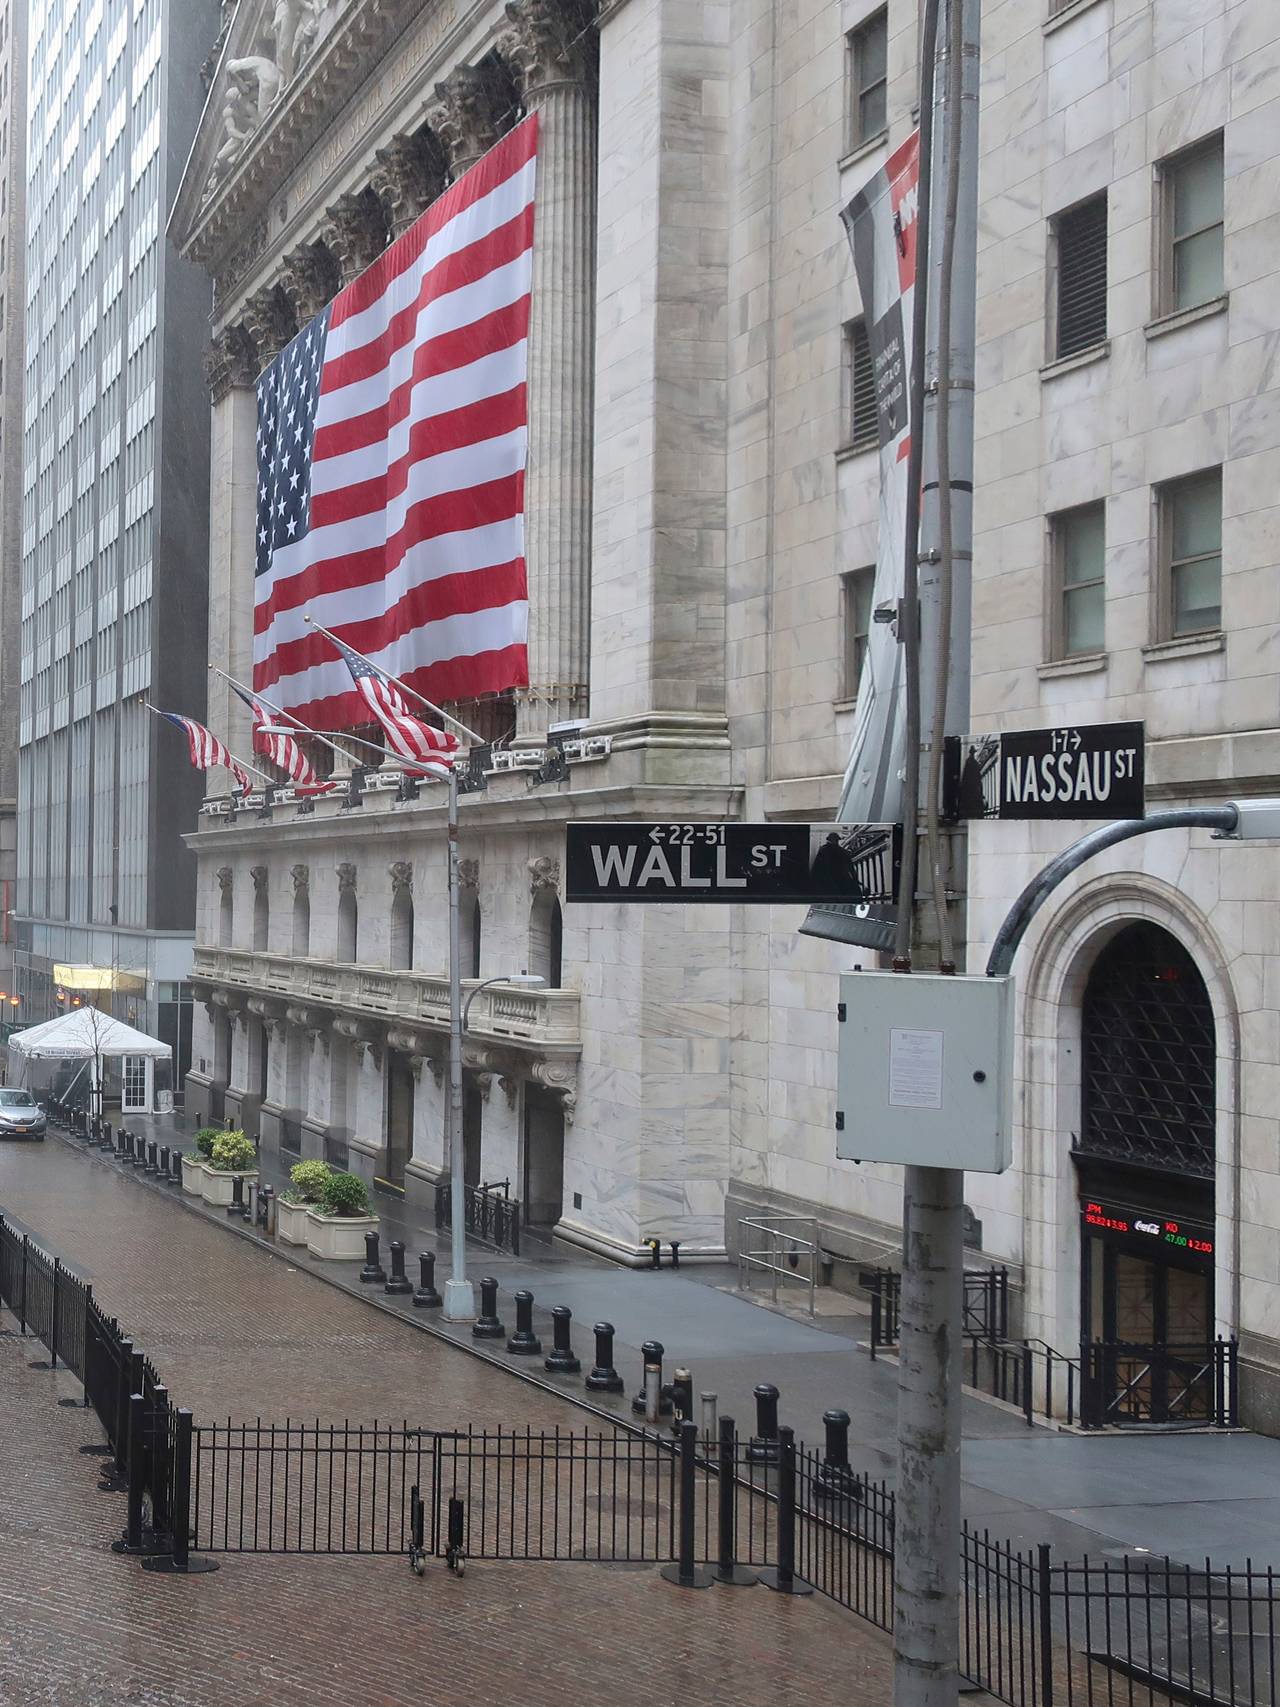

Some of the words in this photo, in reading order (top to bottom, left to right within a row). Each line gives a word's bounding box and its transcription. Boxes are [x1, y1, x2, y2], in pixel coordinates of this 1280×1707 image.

[1051, 730, 1068, 752] 1-7
[1006, 751, 1111, 802] NASSAU
[1115, 749, 1136, 778] ST
[669, 825, 725, 845] 22-51
[591, 845, 747, 888] WALL
[751, 845, 787, 867] ST
[1088, 1203, 1101, 1214] JPM
[1166, 1222, 1178, 1233] KO
